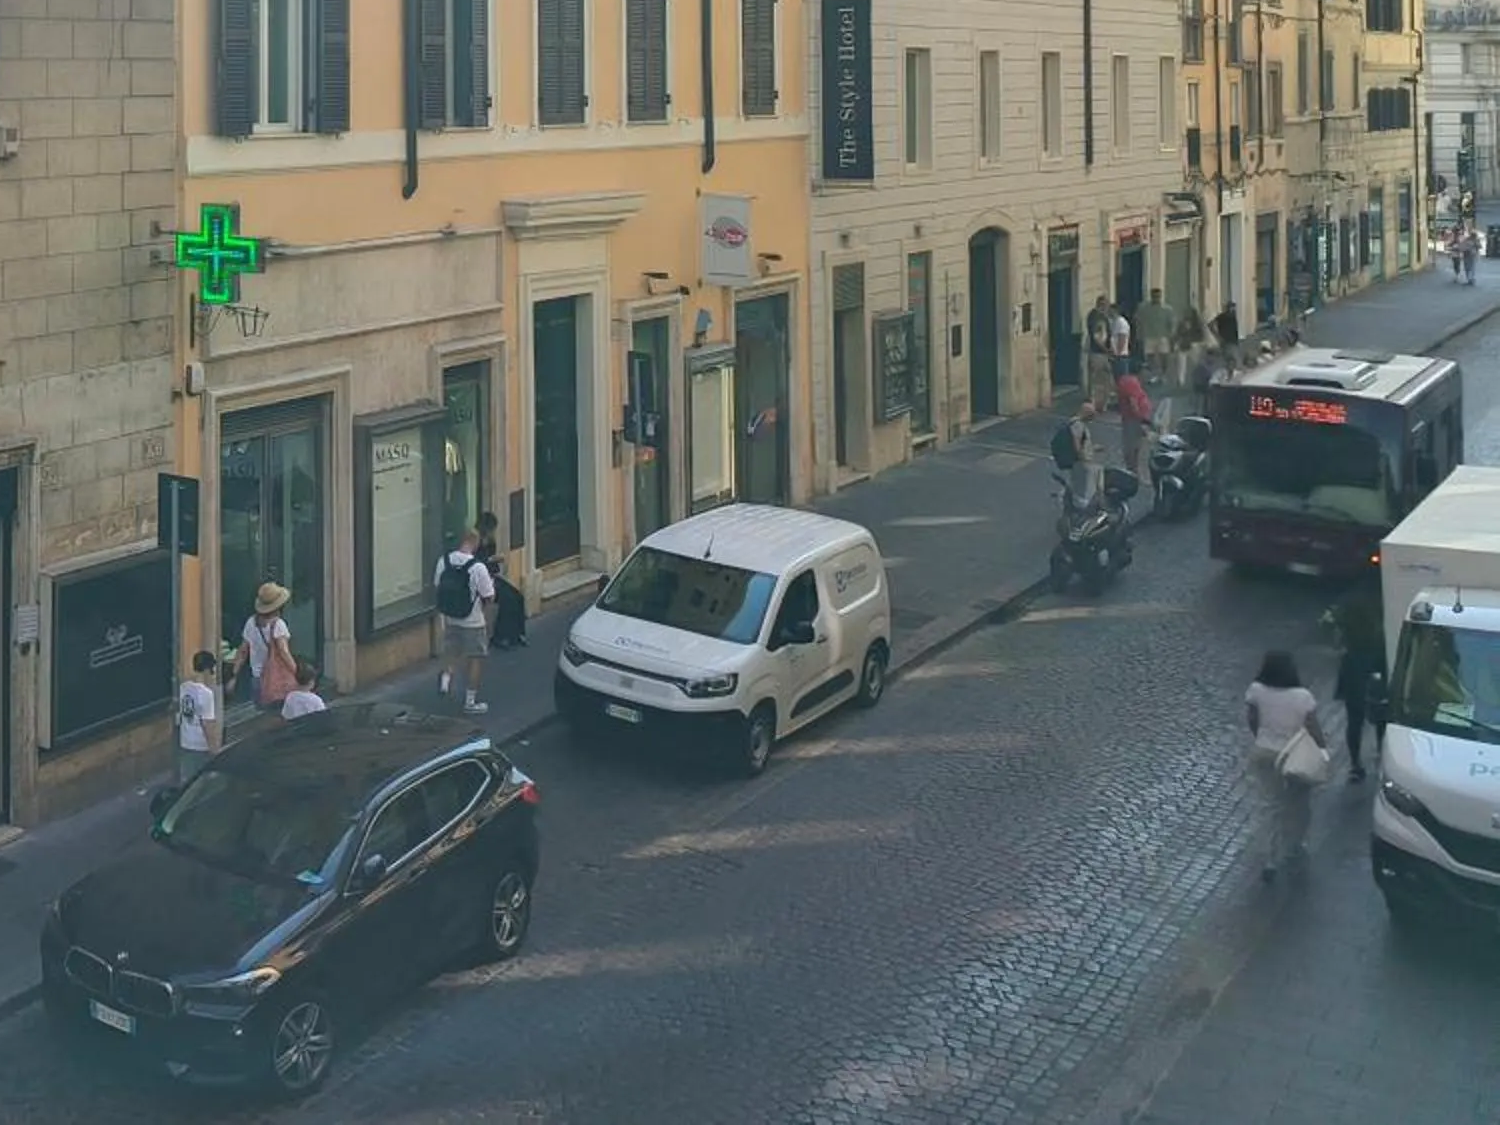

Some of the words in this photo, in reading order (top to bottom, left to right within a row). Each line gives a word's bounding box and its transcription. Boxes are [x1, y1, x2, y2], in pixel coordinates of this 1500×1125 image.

[837, 6, 856, 61] Hotel
[837, 69, 861, 121] Style
[839, 127, 857, 168] The
